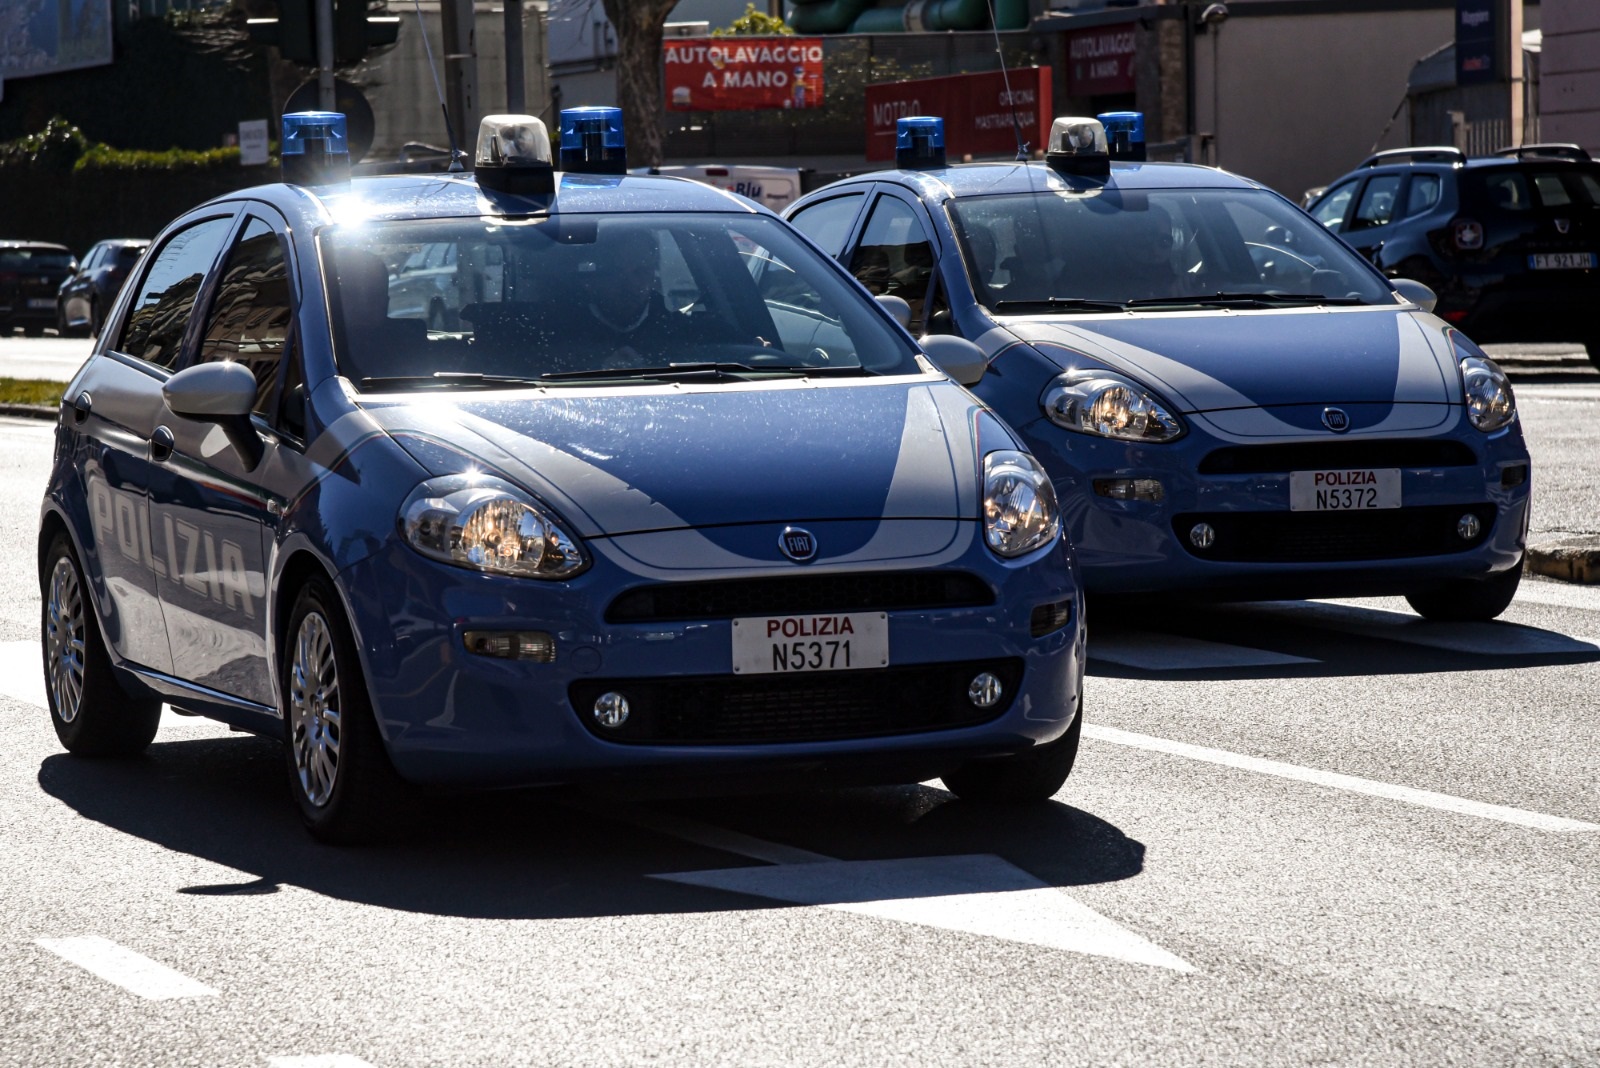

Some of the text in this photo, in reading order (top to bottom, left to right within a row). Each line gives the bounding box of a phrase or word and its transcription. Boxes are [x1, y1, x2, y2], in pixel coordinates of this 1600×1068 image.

[665, 46, 823, 64] AUTOLAVAGGIO
[702, 71, 788, 88] A MANO
[1328, 413, 1345, 425] FIAT
[1314, 471, 1377, 486] POLIZIA
[1316, 488, 1378, 510] N5372
[92, 478, 255, 620] POLIZIA
[787, 536, 810, 552] FIAT
[766, 617, 854, 638] POLIZIA
[772, 640, 851, 671] N5371
